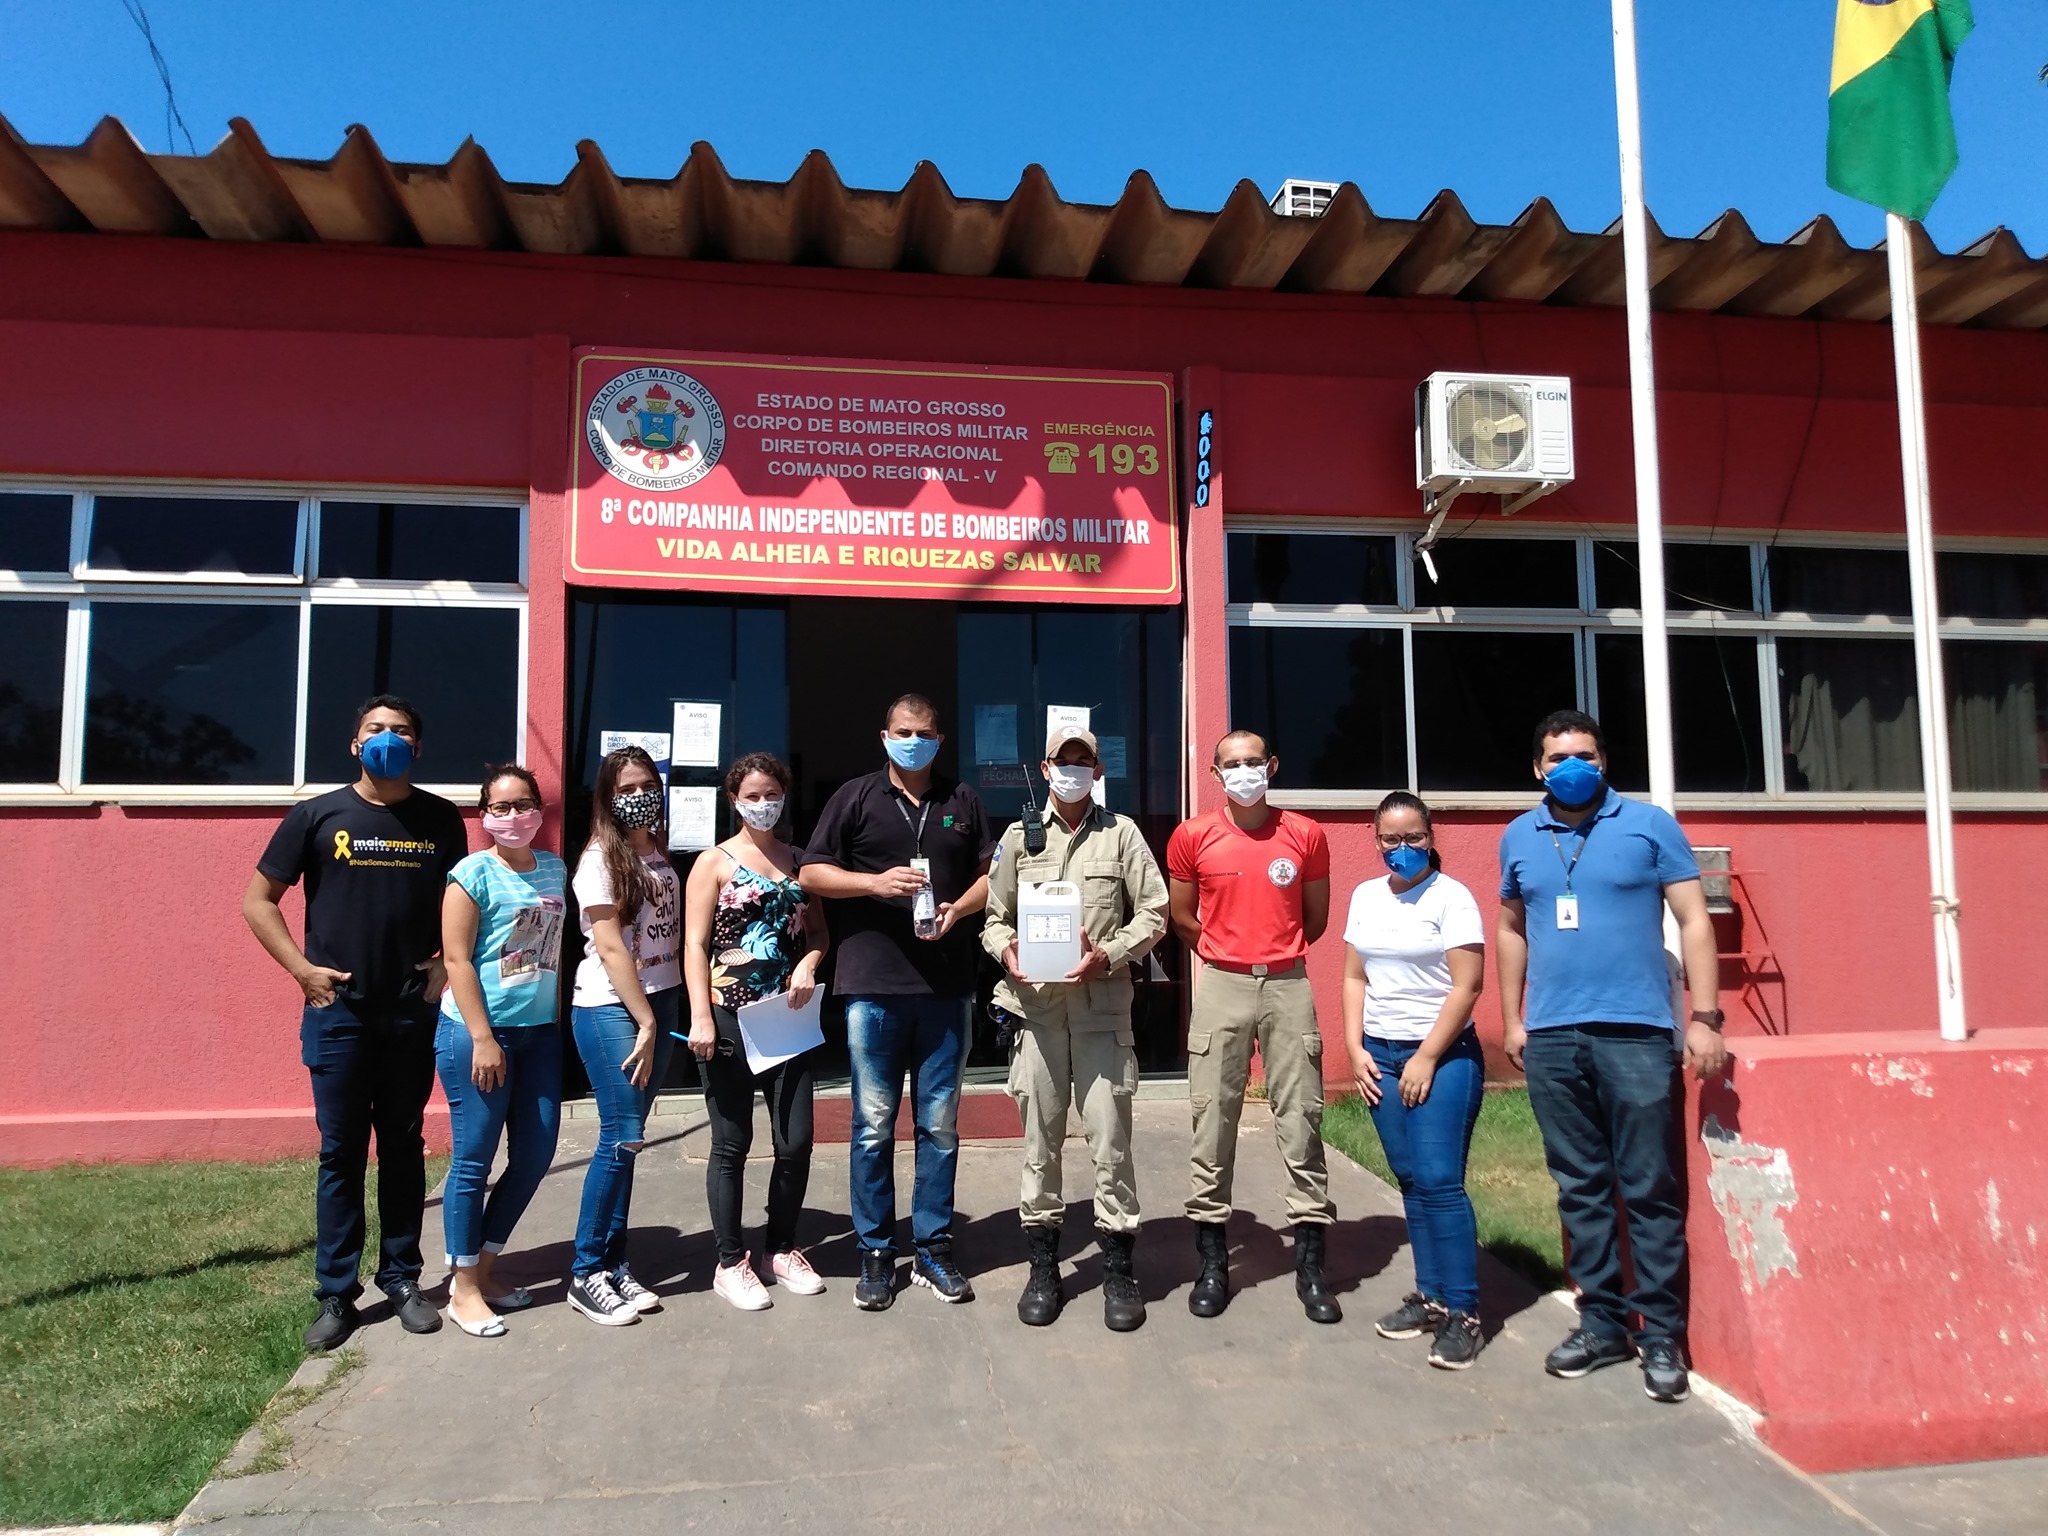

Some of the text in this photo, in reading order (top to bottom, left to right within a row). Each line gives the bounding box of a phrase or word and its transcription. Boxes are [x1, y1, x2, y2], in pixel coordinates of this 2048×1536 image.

[590, 369, 723, 429] ESTADO DE MATO GROSSO
[757, 393, 1006, 417] ESTADO DE MATO GROSSO
[1536, 391, 1567, 401] ELGIN
[733, 414, 1028, 440] CORPO DE BOMBEIROS MILITAR
[1043, 422, 1155, 437] EMERGÊNCIA
[589, 429, 723, 489] CORPO DE BOMBEIROS MILITAR
[761, 438, 1003, 462] DIRETORIA OPERACIONAL
[1088, 443, 1159, 475] 193
[767, 461, 867, 478] COMANDO
[872, 465, 969, 482] REGIONAL
[984, 470, 997, 484] V
[600, 498, 1150, 544] 8ª COMPANHIA INDEPENDENTE DE BOMBEIROS MILITAR
[656, 537, 1102, 573] VIDA ALHEIA E RIQUEZAS SALVAR
[982, 769, 1036, 782] FECHADO
